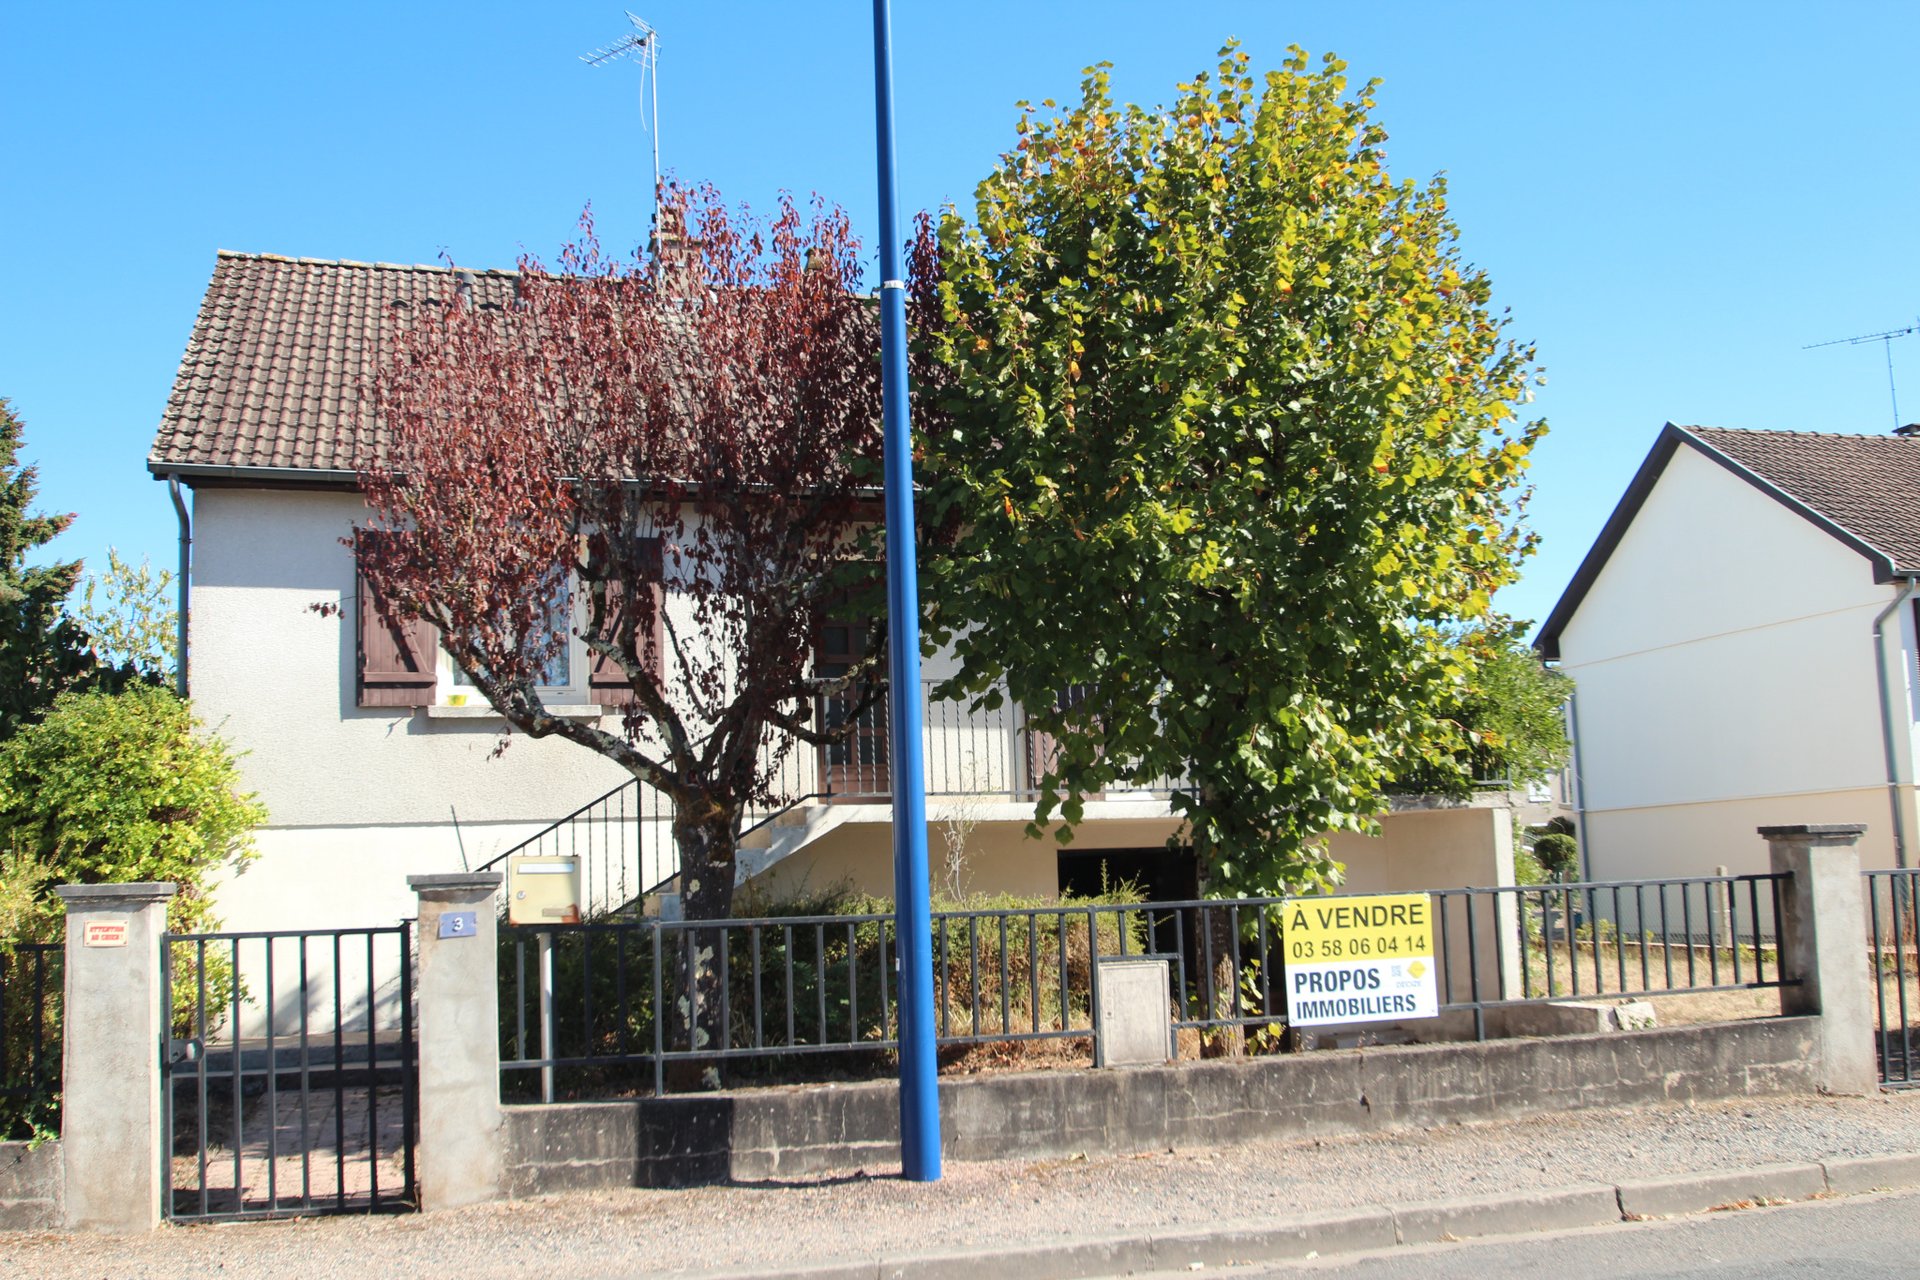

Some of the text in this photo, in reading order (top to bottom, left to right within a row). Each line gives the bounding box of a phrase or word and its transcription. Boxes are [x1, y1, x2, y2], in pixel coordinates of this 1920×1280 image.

[453, 917, 464, 931] 3
[1291, 903, 1424, 931] À VENDRE
[1292, 935, 1426, 958] 03 58 06 04 14
[1294, 968, 1381, 994] PROPOS
[1296, 994, 1416, 1019] IMMOBILIERS
